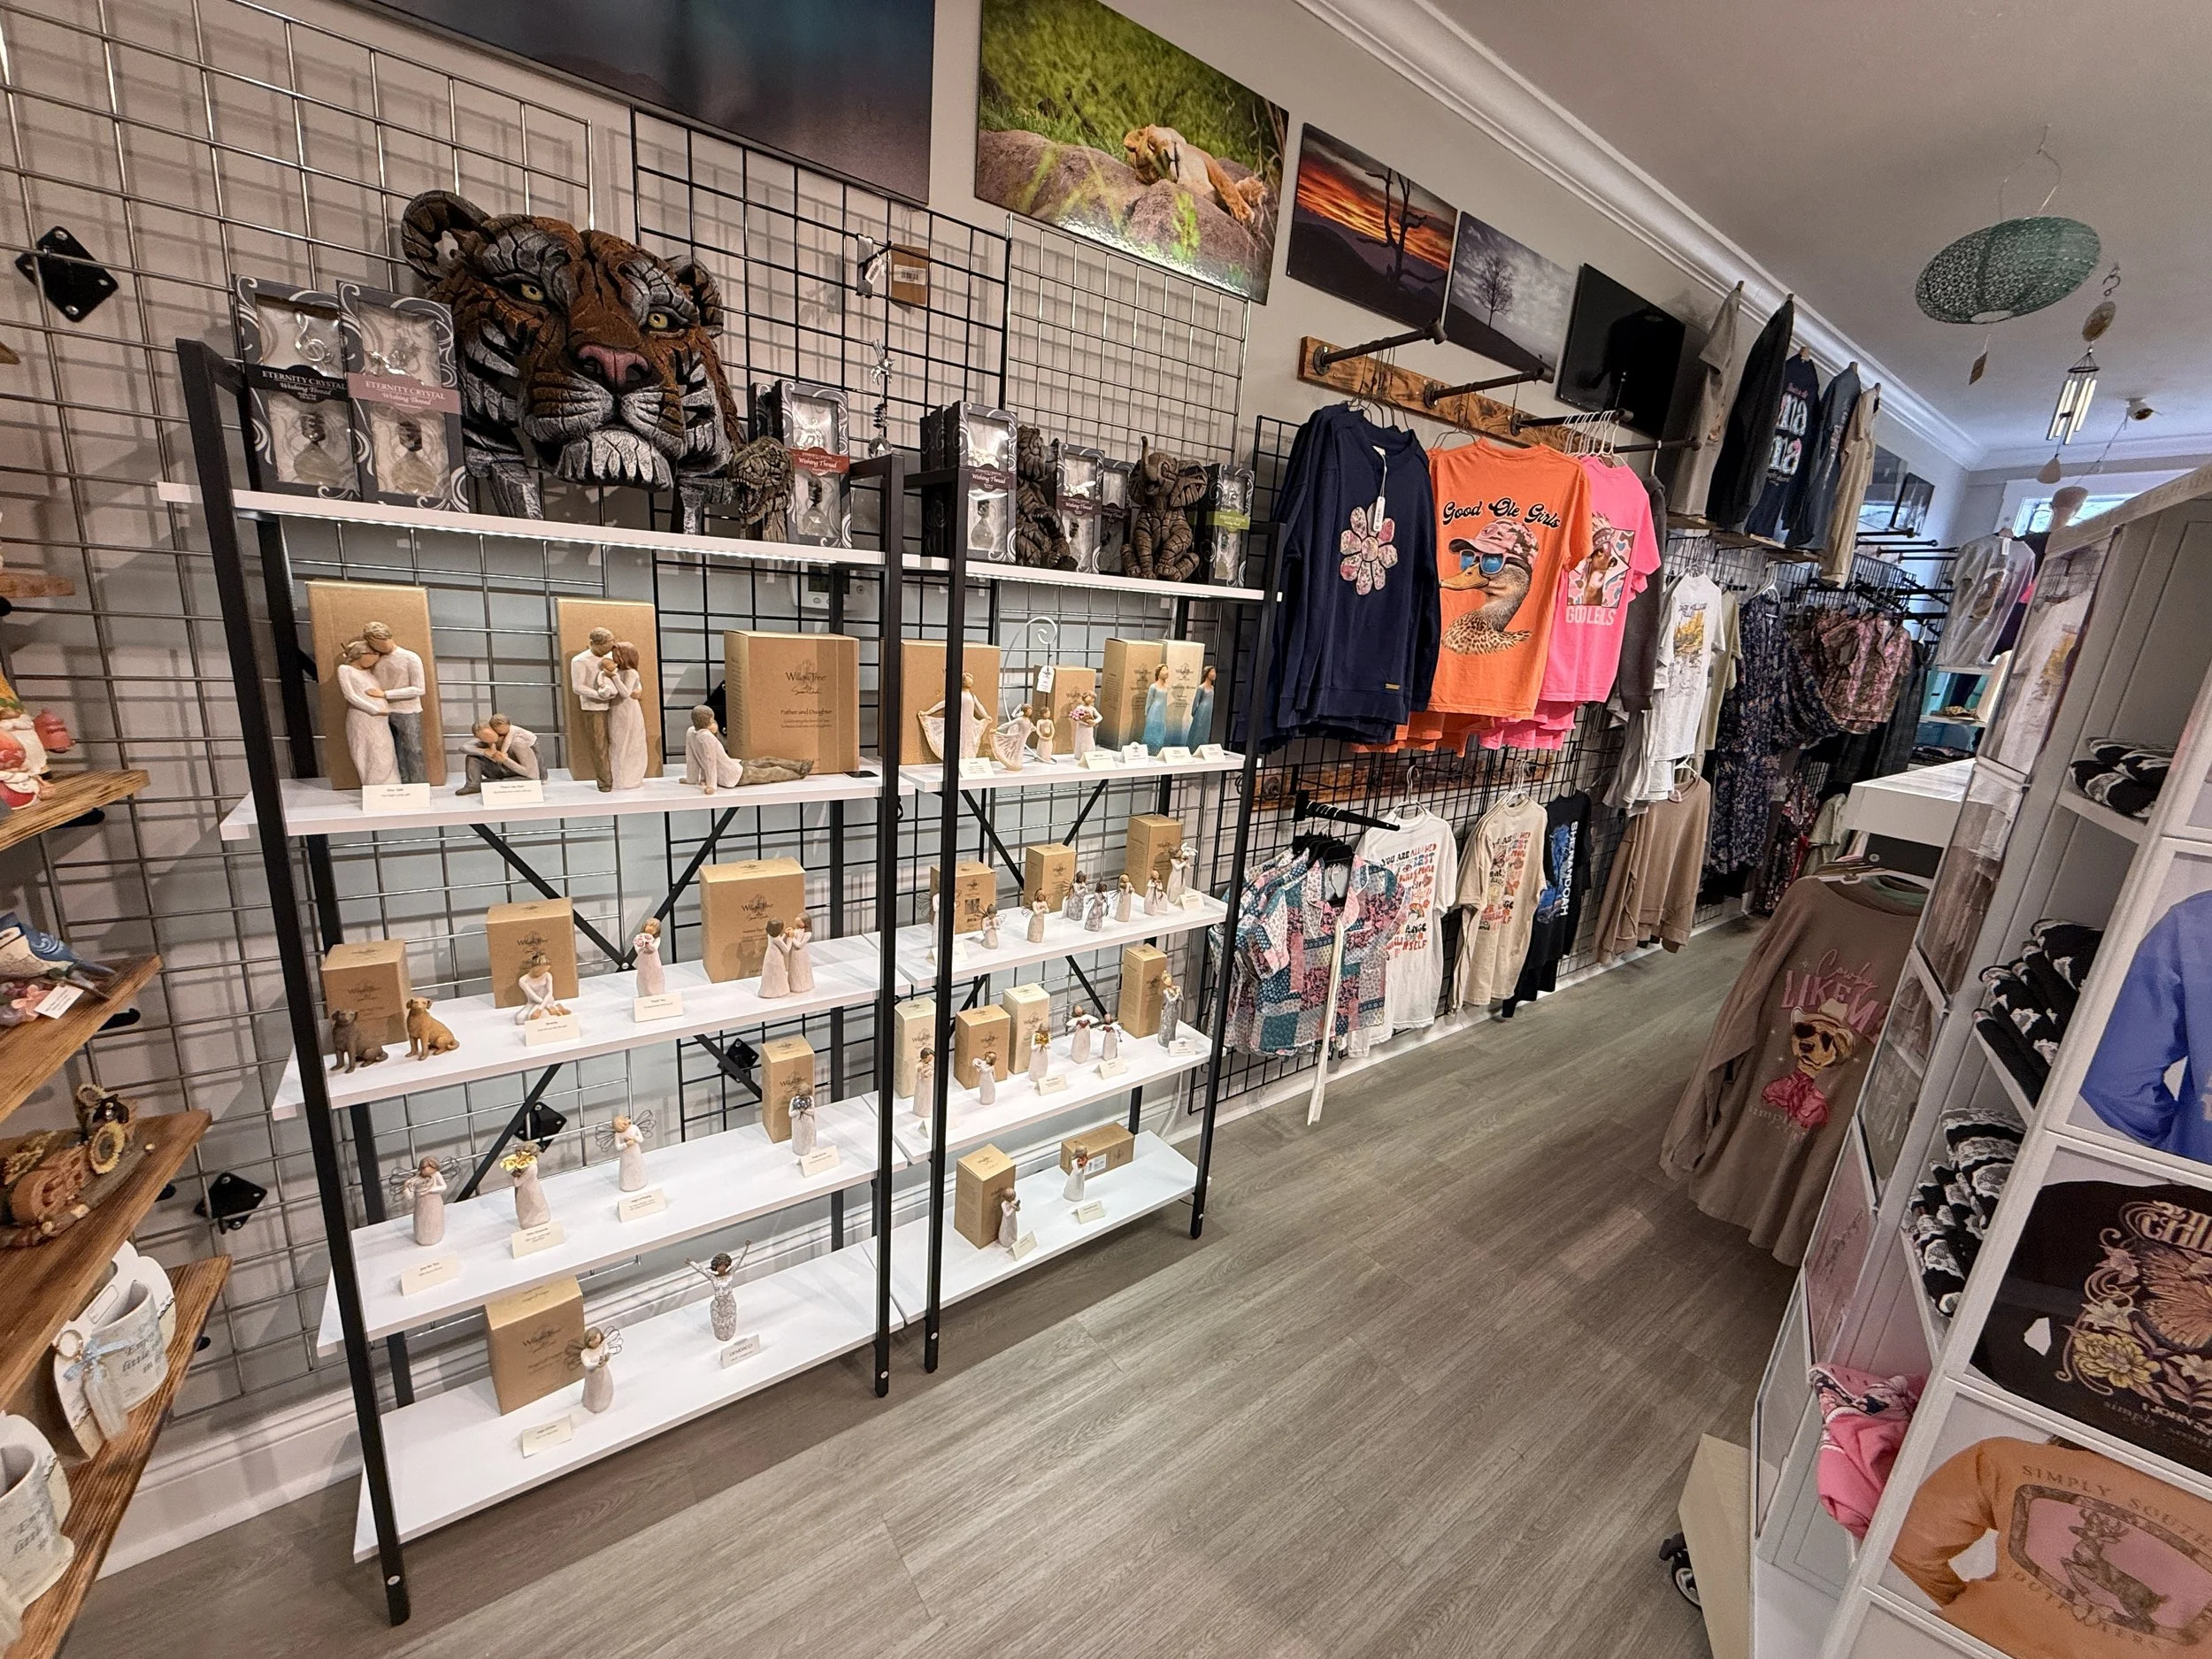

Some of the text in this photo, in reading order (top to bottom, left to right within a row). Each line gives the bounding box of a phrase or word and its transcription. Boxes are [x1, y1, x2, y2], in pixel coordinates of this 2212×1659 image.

[262, 370, 347, 389] ETERNITY CRYSTAL
[280, 382, 332, 396] Wishing Thread
[365, 380, 445, 399] ETERNITY CRYSTAL
[799, 457, 819, 467] Wishing
[972, 473, 990, 484] Wishing
[1442, 497, 1562, 528] Good Ole Girls
[1560, 820, 1578, 917] SHENANDOAH
[1780, 970, 1854, 1010] LIKE
[2021, 1463, 2113, 1497] SIMPLY
